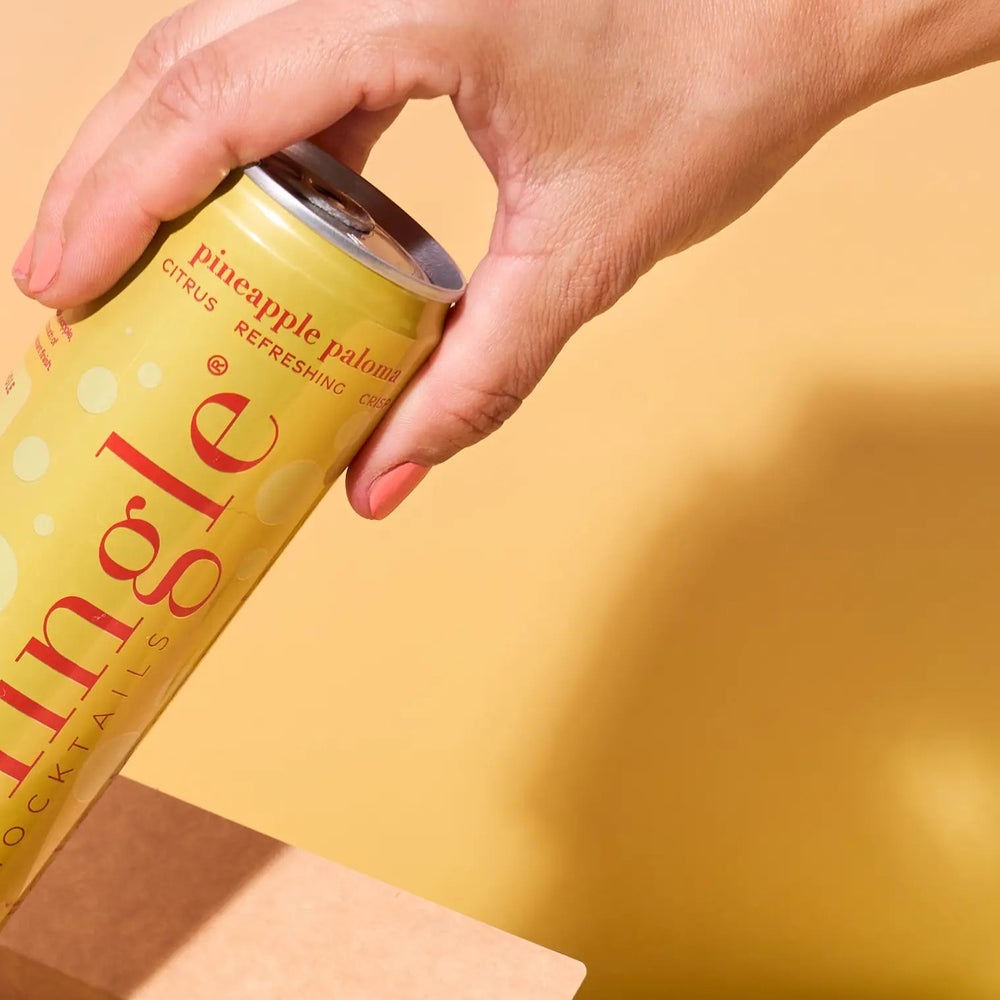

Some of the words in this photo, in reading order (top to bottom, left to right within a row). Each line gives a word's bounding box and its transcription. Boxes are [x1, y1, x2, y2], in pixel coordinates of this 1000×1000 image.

[162, 257, 219, 312] CITRUS
[234, 319, 347, 396] REFRESHING
[187, 241, 321, 345] pineapple
[317, 338, 403, 384] paloma
